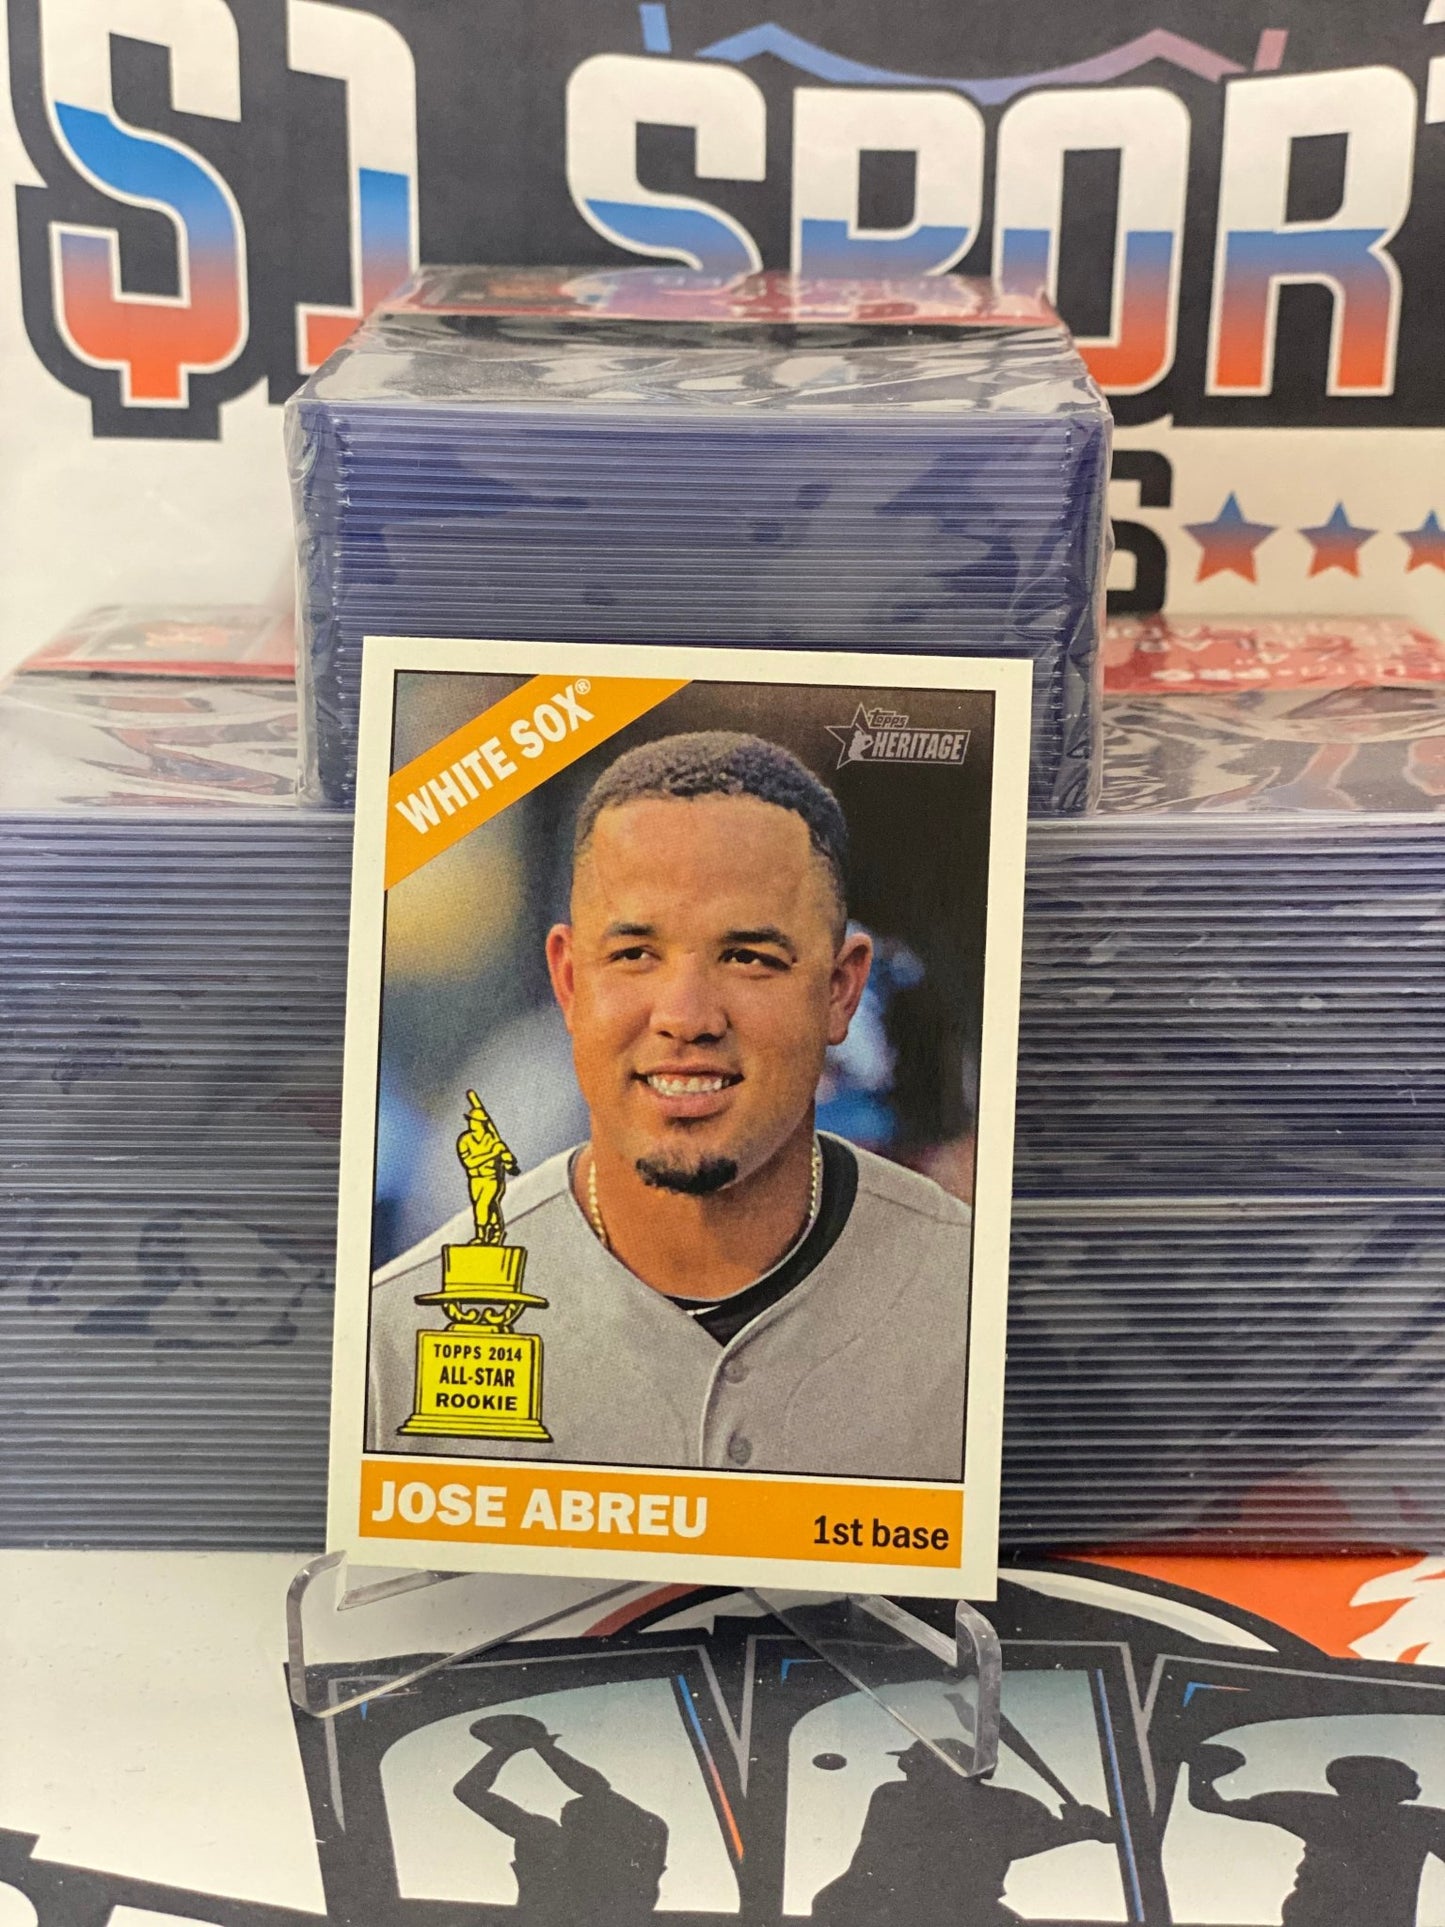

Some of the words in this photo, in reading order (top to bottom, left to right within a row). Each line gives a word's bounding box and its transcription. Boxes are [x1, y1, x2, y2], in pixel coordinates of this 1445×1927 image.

[566, 54, 1445, 398] SPOR
[871, 731, 965, 760] HERITAGE
[395, 737, 518, 835] WHITE
[434, 1343, 482, 1360] TOPPS
[488, 1347, 522, 1362] 2014
[439, 1365, 515, 1388] ALL-STAR
[435, 1392, 518, 1411] ROOKIE
[371, 1481, 507, 1528] JOSE
[520, 1489, 708, 1538] ABREU
[813, 1515, 863, 1546] 1st
[871, 1517, 950, 1551] base
